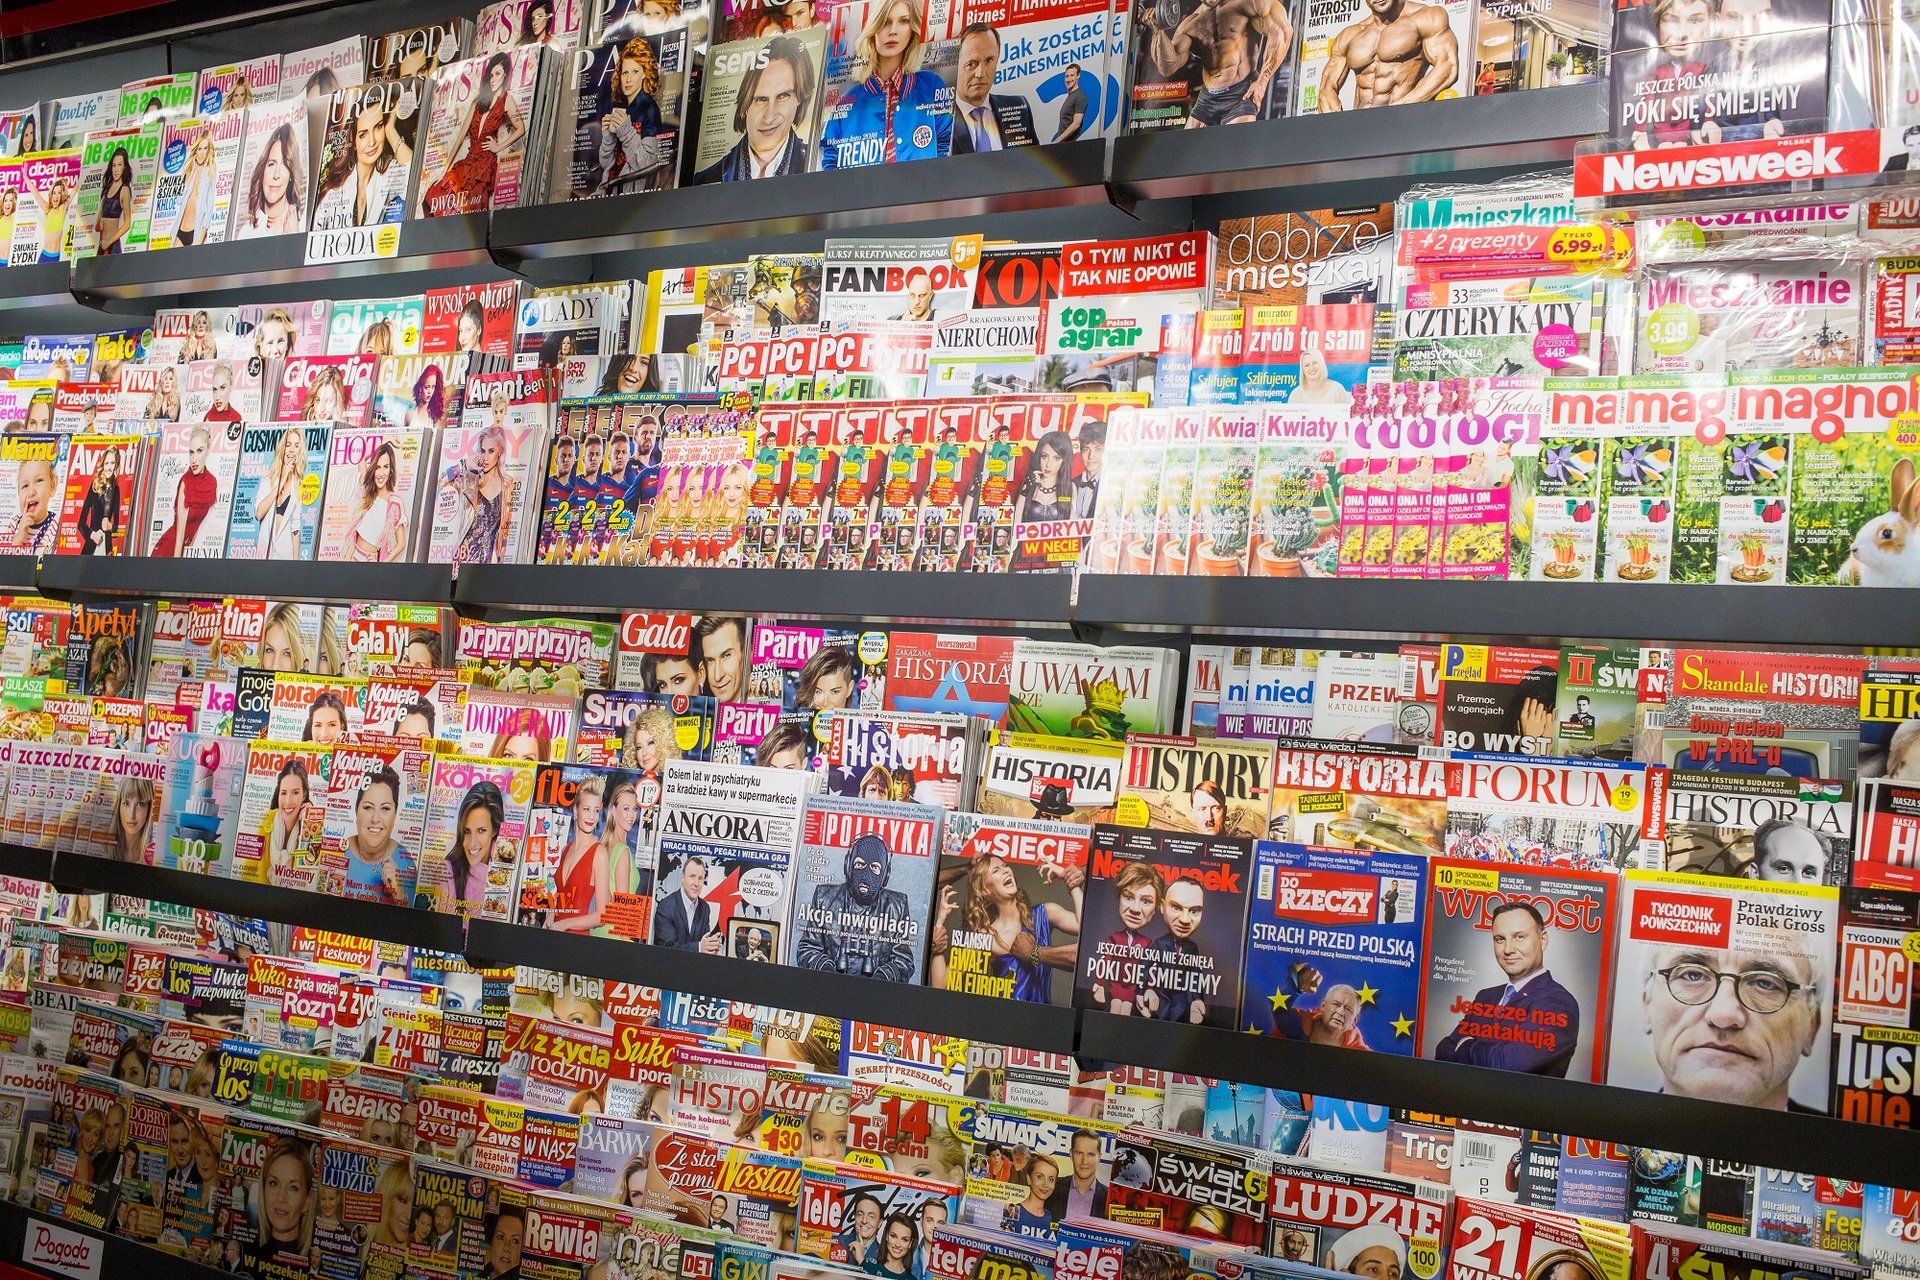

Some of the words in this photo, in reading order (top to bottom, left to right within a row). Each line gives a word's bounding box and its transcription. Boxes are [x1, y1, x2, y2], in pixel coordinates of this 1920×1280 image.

[966, 8, 1006, 27] Biznes
[1308, 16, 1331, 28] FAKTY
[1338, 12, 1352, 24] MITY
[1001, 42, 1031, 65] Jak
[1038, 15, 1104, 52] zostać
[713, 47, 770, 75] sens
[994, 41, 1105, 85] BIZNESMENEM
[1633, 78, 1675, 97] JESZCZE
[1677, 75, 1719, 90] POLSKA
[1622, 99, 1667, 127] PÓKI
[1672, 96, 1699, 123] SIĘ
[1705, 86, 1801, 118] ŚMIEJEMY
[837, 138, 888, 167] TRENDY
[1777, 138, 1811, 147] POLSKA
[1603, 137, 1845, 193] Newsweek
[431, 191, 469, 212] DWOJE
[12, 242, 38, 255] SMUKŁE
[308, 230, 375, 260] URODA
[1090, 247, 1129, 265] TYM
[1133, 243, 1176, 261] NIKT
[1180, 240, 1196, 256] CI
[1228, 219, 1380, 266] dobrze
[1552, 239, 1592, 255] 6,99
[11, 250, 38, 265] ŁYDKI
[826, 249, 857, 259] KURSY
[857, 250, 917, 258] KREATYWNEGO
[919, 249, 948, 258] PISANIA
[1069, 270, 1101, 287] TAK
[1105, 269, 1135, 284] NIE
[1135, 262, 1196, 280] OPOWIE
[1226, 255, 1383, 292] mieszkaj
[1452, 288, 1468, 304] 33
[542, 296, 599, 322] LADY
[1060, 306, 1106, 328] top
[1257, 309, 1294, 319] murator
[1106, 318, 1136, 327] Polska
[1059, 325, 1142, 352] agrar
[1250, 328, 1293, 354] zrób
[1300, 331, 1318, 353] to
[1323, 330, 1366, 353] sam
[818, 336, 855, 369] PC
[1407, 348, 1483, 359] MINISYPIALNIA
[566, 366, 586, 378] prix
[567, 360, 586, 371] bon
[122, 371, 162, 392] VIVA!
[1246, 372, 1299, 388] Szlifujemy,
[1823, 373, 1864, 381] PORADY
[1867, 372, 1907, 380] EKSPERTÓW
[1267, 411, 1338, 442] Kwiaty
[1448, 493, 1468, 504] ONA
[1476, 492, 1490, 504] ON
[1537, 502, 1564, 510] Doniczki
[1043, 539, 1079, 553] NECIE
[72, 602, 137, 647] Apetyt
[224, 608, 263, 638] tina
[411, 613, 437, 623] HISTORII
[622, 616, 687, 649] Gala
[895, 649, 931, 657] ZAKAZANA
[938, 639, 976, 649] warszawska
[67, 649, 88, 662] AZJA
[751, 670, 782, 679] STRONY!
[752, 663, 777, 671] NOWE
[893, 657, 1011, 685] HISTORIA
[1681, 655, 1768, 694] Skandale
[1772, 673, 1858, 699] HISTORII
[5, 681, 44, 693] GULASZE
[1328, 703, 1380, 713] KATOLICKI
[1457, 693, 1495, 705] Przemoc
[105, 705, 144, 719] PRZEPISY
[1456, 704, 1504, 716] agencjach
[1690, 716, 1727, 737] Domy
[1730, 719, 1784, 738] uciech
[842, 718, 964, 774] Historia
[1293, 740, 1320, 749] świat
[1322, 741, 1356, 754] wiedzy
[1444, 731, 1479, 750] BO
[1715, 737, 1780, 768] PRL-u
[668, 767, 693, 781] Osiem
[711, 773, 761, 788] psychiatryku
[991, 756, 1112, 791] HISTORIA
[1128, 745, 1268, 801] HISTORY
[1278, 751, 1447, 797] HISTORIA
[1672, 774, 1709, 783] TRAGEDIA
[1711, 777, 1743, 785] FESTUNG
[1746, 779, 1785, 787] BUDAPEST
[706, 787, 726, 800] kawy
[738, 790, 797, 805] supermarkecie
[1466, 764, 1633, 811] FORUM
[1648, 770, 1664, 838] Newsweek
[661, 812, 764, 842] ANGORA
[663, 842, 685, 851] WRACA
[687, 844, 712, 854] SONDA,
[714, 846, 737, 855] PEGAZ
[742, 850, 769, 861] WIELKA
[771, 854, 787, 863] GRA
[974, 834, 1066, 864] wSIECI
[274, 864, 315, 880] Wiosenny
[1281, 877, 1299, 888] DO
[1439, 870, 1452, 884] 10
[1455, 871, 1488, 882] SPOSOBÓW,
[1464, 880, 1494, 890] SCHUDNĄĆ
[614, 895, 644, 906] Wojna?!
[1280, 888, 1374, 915] RZECZY
[1650, 902, 1714, 920] TYGODNIK
[1736, 899, 1823, 923] Prawdziwy
[798, 904, 834, 927] Akcja
[837, 908, 919, 936] inwigilacja
[1640, 915, 1722, 935] POWSZECHNY
[1736, 914, 1779, 929] Polak
[1781, 916, 1825, 933] Gross
[951, 929, 992, 951] ISLAMSKI
[1253, 924, 1302, 944] STRACH
[1308, 928, 1355, 950] PRZED
[1360, 932, 1415, 962] POLSKĄ
[1847, 933, 1900, 946] TYGODNIK
[949, 948, 992, 974] GWAŁT
[1096, 942, 1128, 957] JESZCZE
[1129, 946, 1160, 961] POLSKA
[1179, 952, 1214, 970] ZGINĘŁA
[1087, 956, 1122, 980] PÓKI
[1124, 963, 1144, 987] SIĘ
[1148, 964, 1221, 995] ŚMIEJEMY
[1848, 947, 1902, 1004] ABC
[963, 975, 1016, 999] EUROPIE
[1451, 995, 1527, 1022] Jeszcze
[1531, 1009, 1568, 1028] nas
[1458, 1018, 1556, 1051] zaatakują
[894, 1066, 952, 1093] PRZESZŁOŚCI
[130, 1103, 167, 1125] DOBRY
[327, 1089, 400, 1121] Relaks
[596, 1119, 622, 1128] NOWE!
[580, 1127, 650, 1158] BARWY
[1160, 1152, 1244, 1187] świat
[417, 1170, 467, 1193] TWOJE
[1635, 1186, 1652, 1195] JAK
[1654, 1188, 1678, 1197] DZIAŁA
[739, 1200, 769, 1213] BOGUSŁAW
[803, 1189, 840, 1228] Tele
[1273, 1181, 1443, 1237] LUDZIE
[1645, 1195, 1667, 1203] MIECZ
[1111, 1209, 1160, 1220] EKSPERYMENT
[1651, 1212, 1677, 1223] WIERZY
[525, 1212, 597, 1257] Rewia
[1707, 1222, 1746, 1234] MORSKIE
[35, 1225, 90, 1260] Pogoda
[1411, 1238, 1438, 1249] NOWOŚĆ
[1412, 1251, 1435, 1266] 100
